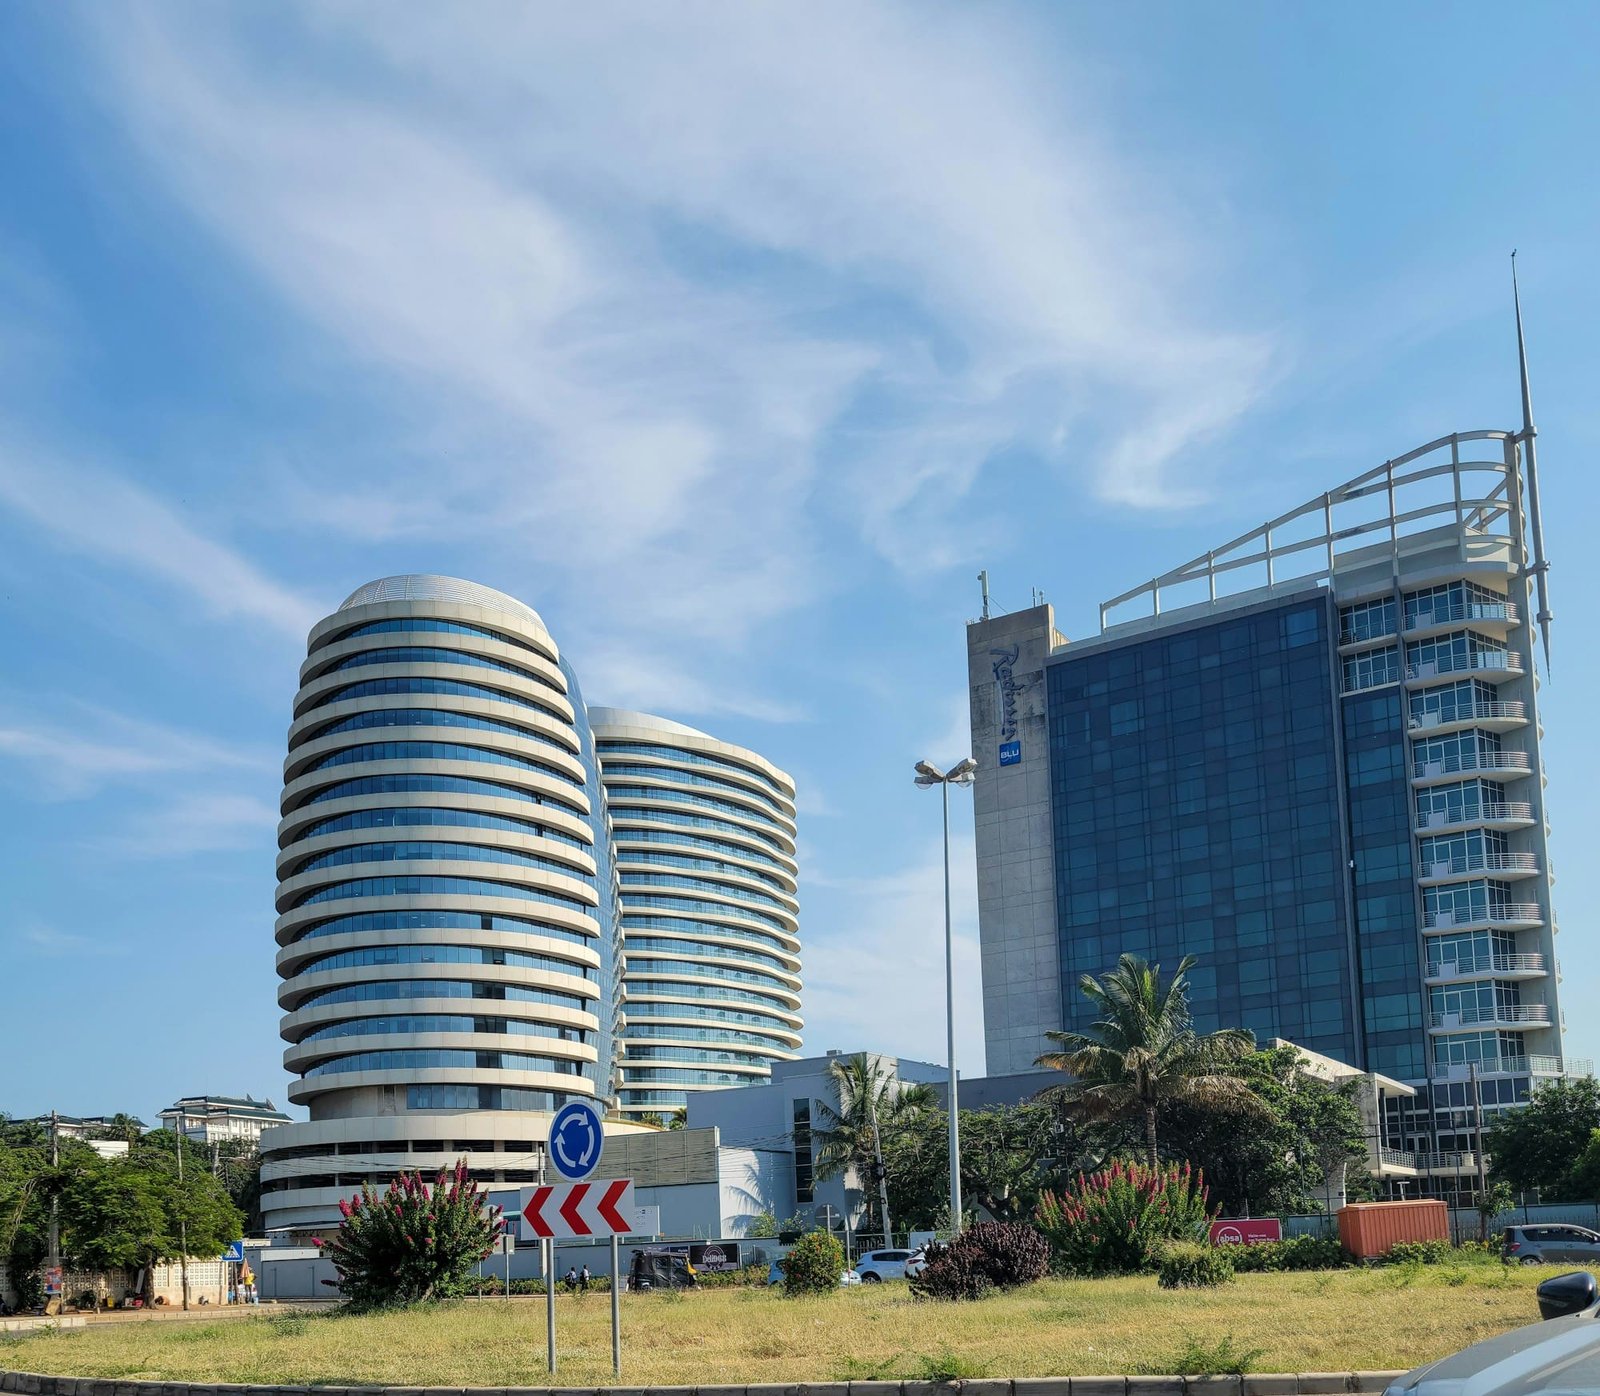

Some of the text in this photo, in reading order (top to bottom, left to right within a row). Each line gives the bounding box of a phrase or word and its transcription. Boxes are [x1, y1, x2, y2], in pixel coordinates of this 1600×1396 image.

[989, 643, 1025, 741] Radisson
[1000, 749, 1019, 759] BLU
[1219, 1234, 1240, 1243] absa
